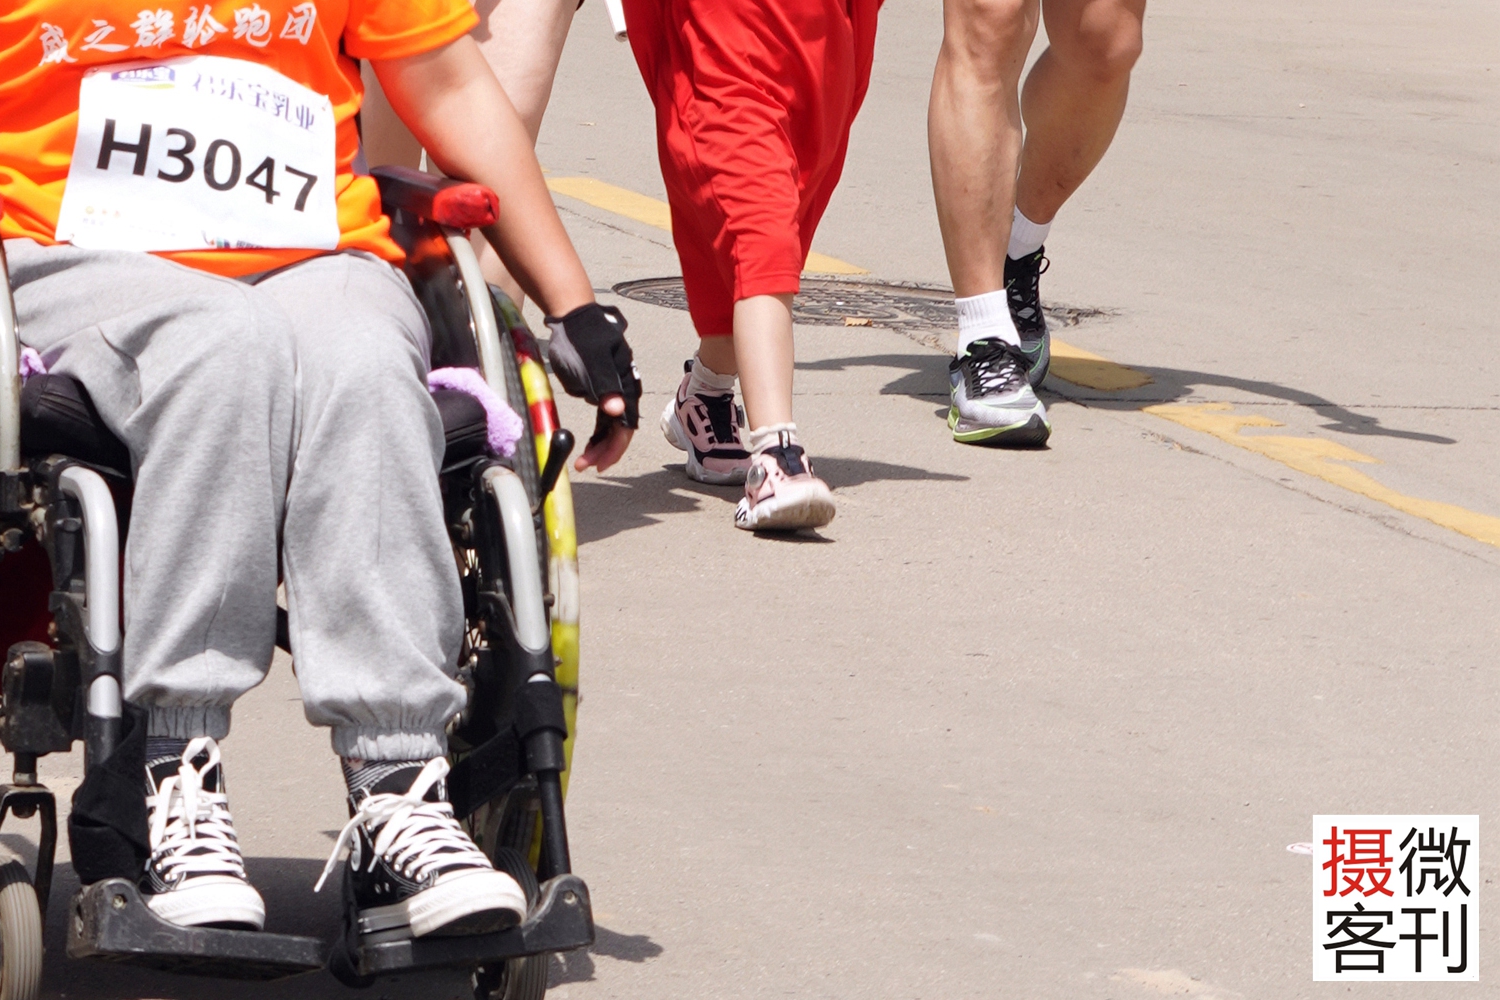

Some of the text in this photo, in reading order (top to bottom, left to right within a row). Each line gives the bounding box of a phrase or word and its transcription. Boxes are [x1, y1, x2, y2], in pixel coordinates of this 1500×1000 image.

[192, 73, 315, 131] 君乐宝乳业
[96, 118, 318, 213] H3047
